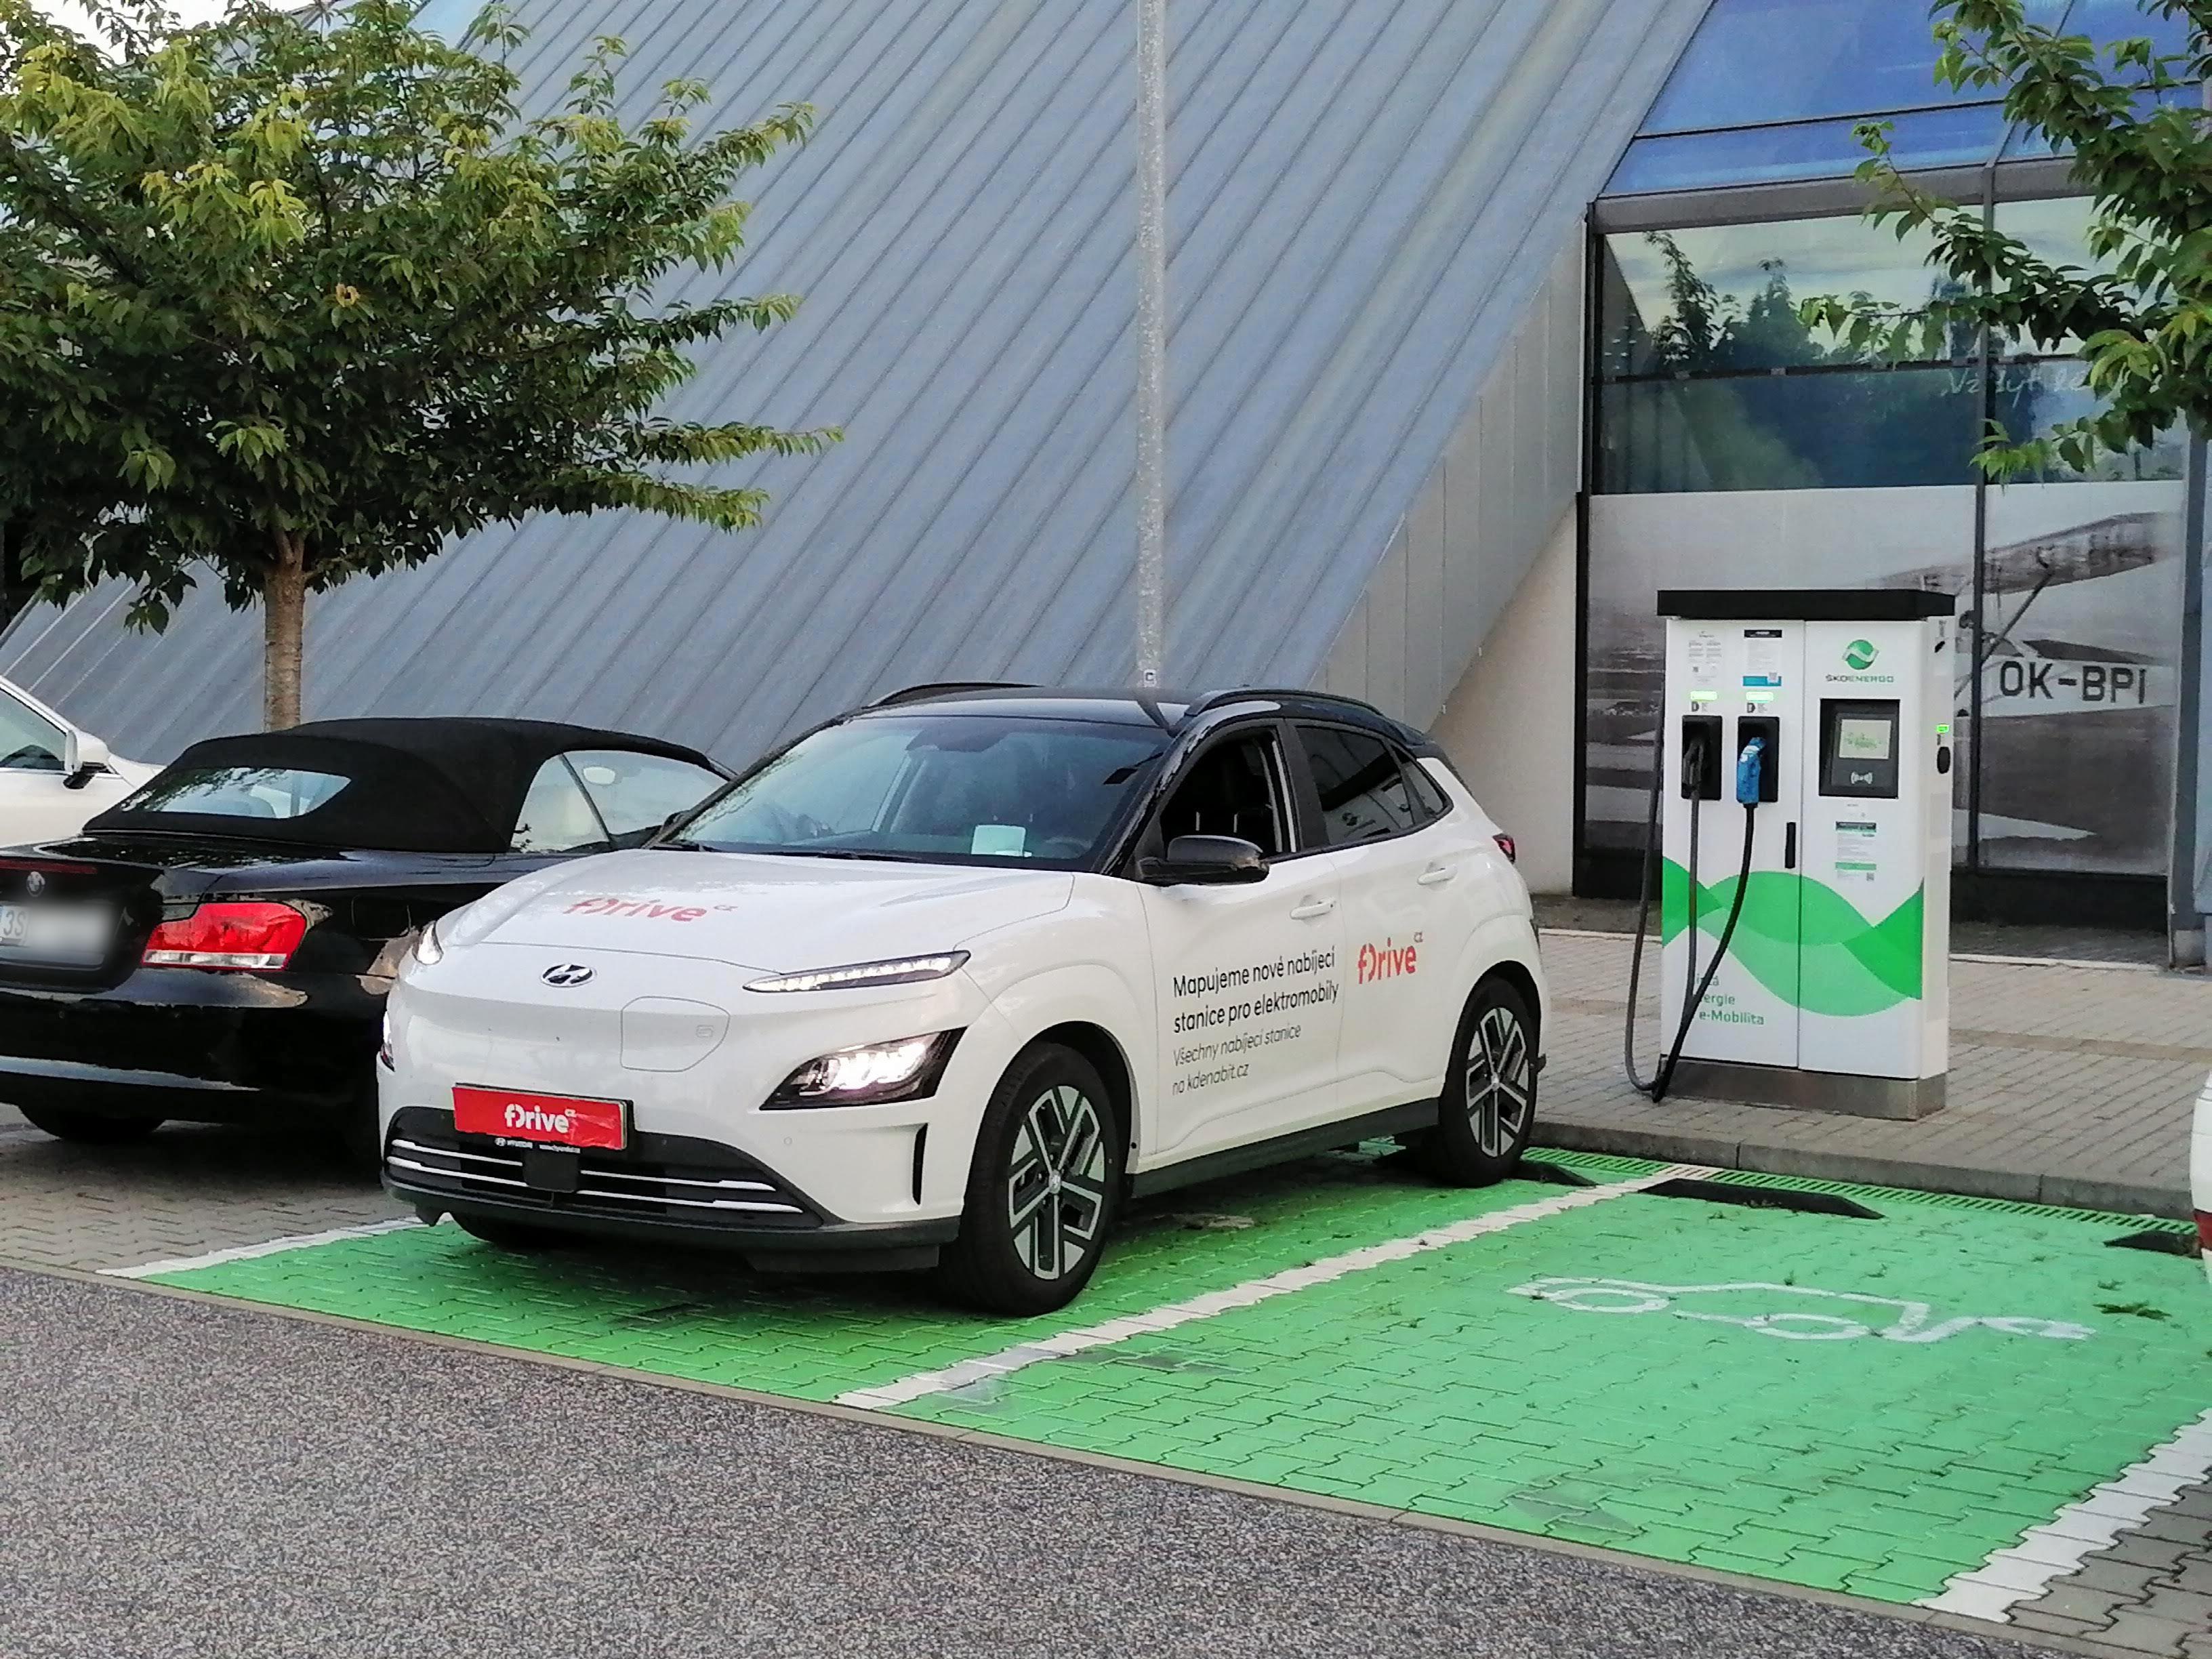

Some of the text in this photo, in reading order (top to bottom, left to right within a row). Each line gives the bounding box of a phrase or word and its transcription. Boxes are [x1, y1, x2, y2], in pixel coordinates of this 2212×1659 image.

[2000, 661, 2146, 704] OK-BPI
[1173, 945, 1335, 998] Mapujeme nové nabíjecí
[1173, 980, 1339, 1033] stanice pro elektromobily
[1173, 1043, 1218, 1066] Všechny
[1265, 1023, 1301, 1044] stanice
[1172, 1080, 1185, 1096] na
[505, 1103, 569, 1133] fDrive
